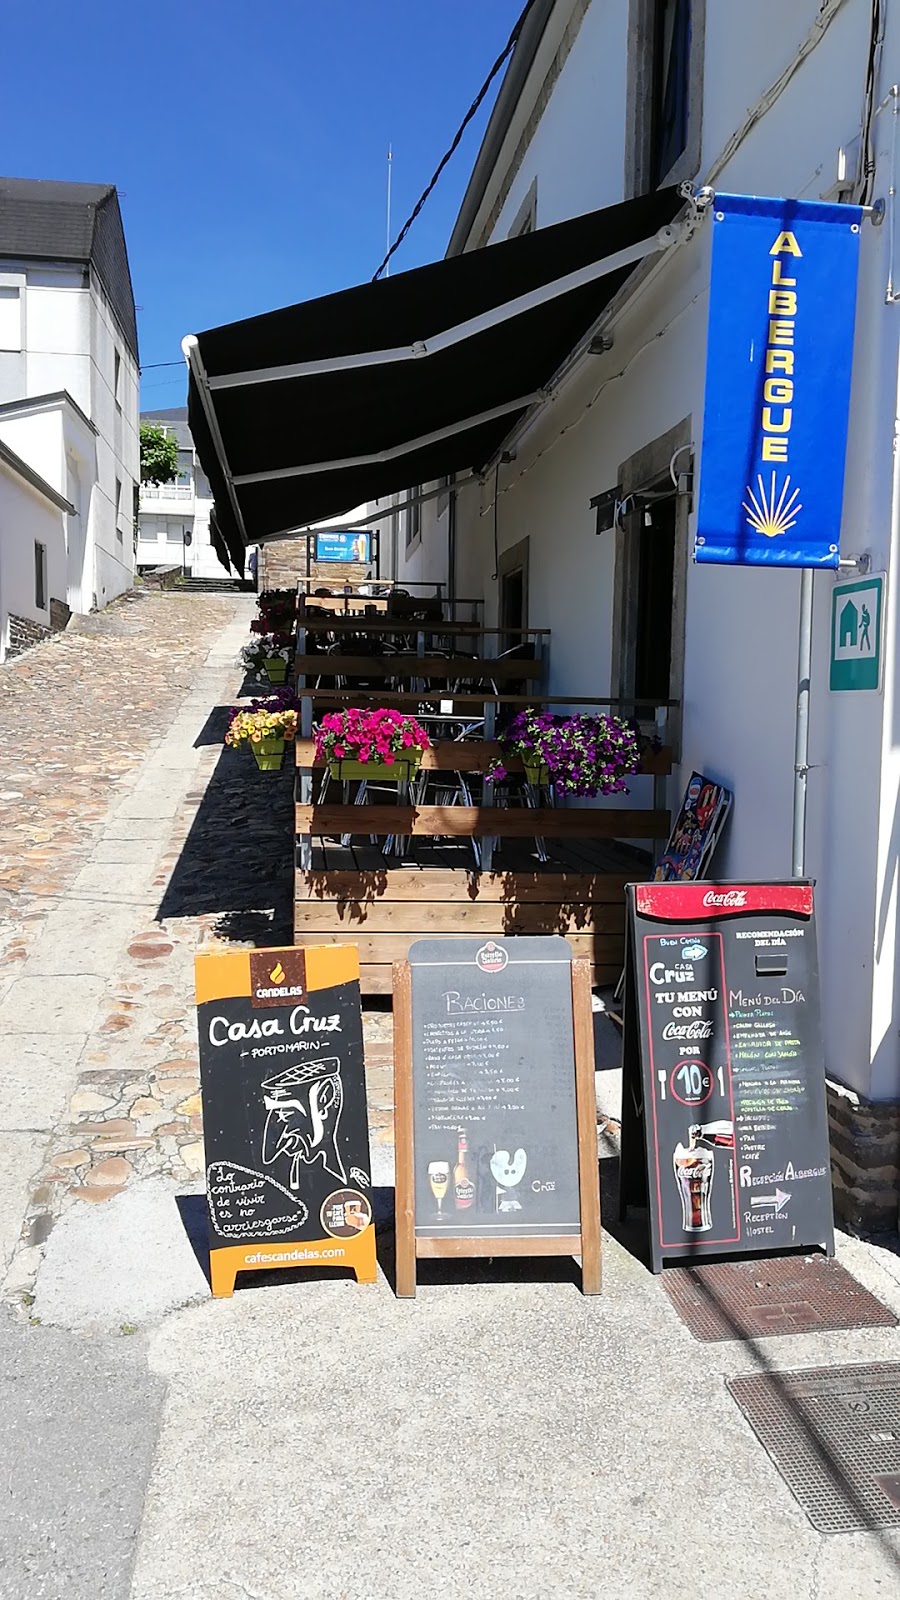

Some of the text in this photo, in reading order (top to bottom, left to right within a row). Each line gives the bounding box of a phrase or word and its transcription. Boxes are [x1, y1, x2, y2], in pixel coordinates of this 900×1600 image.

[762, 231, 803, 462] ALBERGUE
[736, 929, 804, 940] RECOMENDACIÓN
[754, 938, 786, 947] DEL DÍA
[650, 962, 695, 985] Cruz
[256, 986, 302, 998] CANDELAS
[655, 988, 718, 1004] TU MENÚ
[672, 1006, 702, 1017] CON
[209, 1006, 342, 1046] Casa Cruz
[679, 1046, 700, 1055] POR
[211, 1179, 265, 1194] contrario
[217, 1197, 230, 1207] de
[219, 1207, 255, 1219] es no
[244, 1248, 345, 1264] cafescandelas.com
